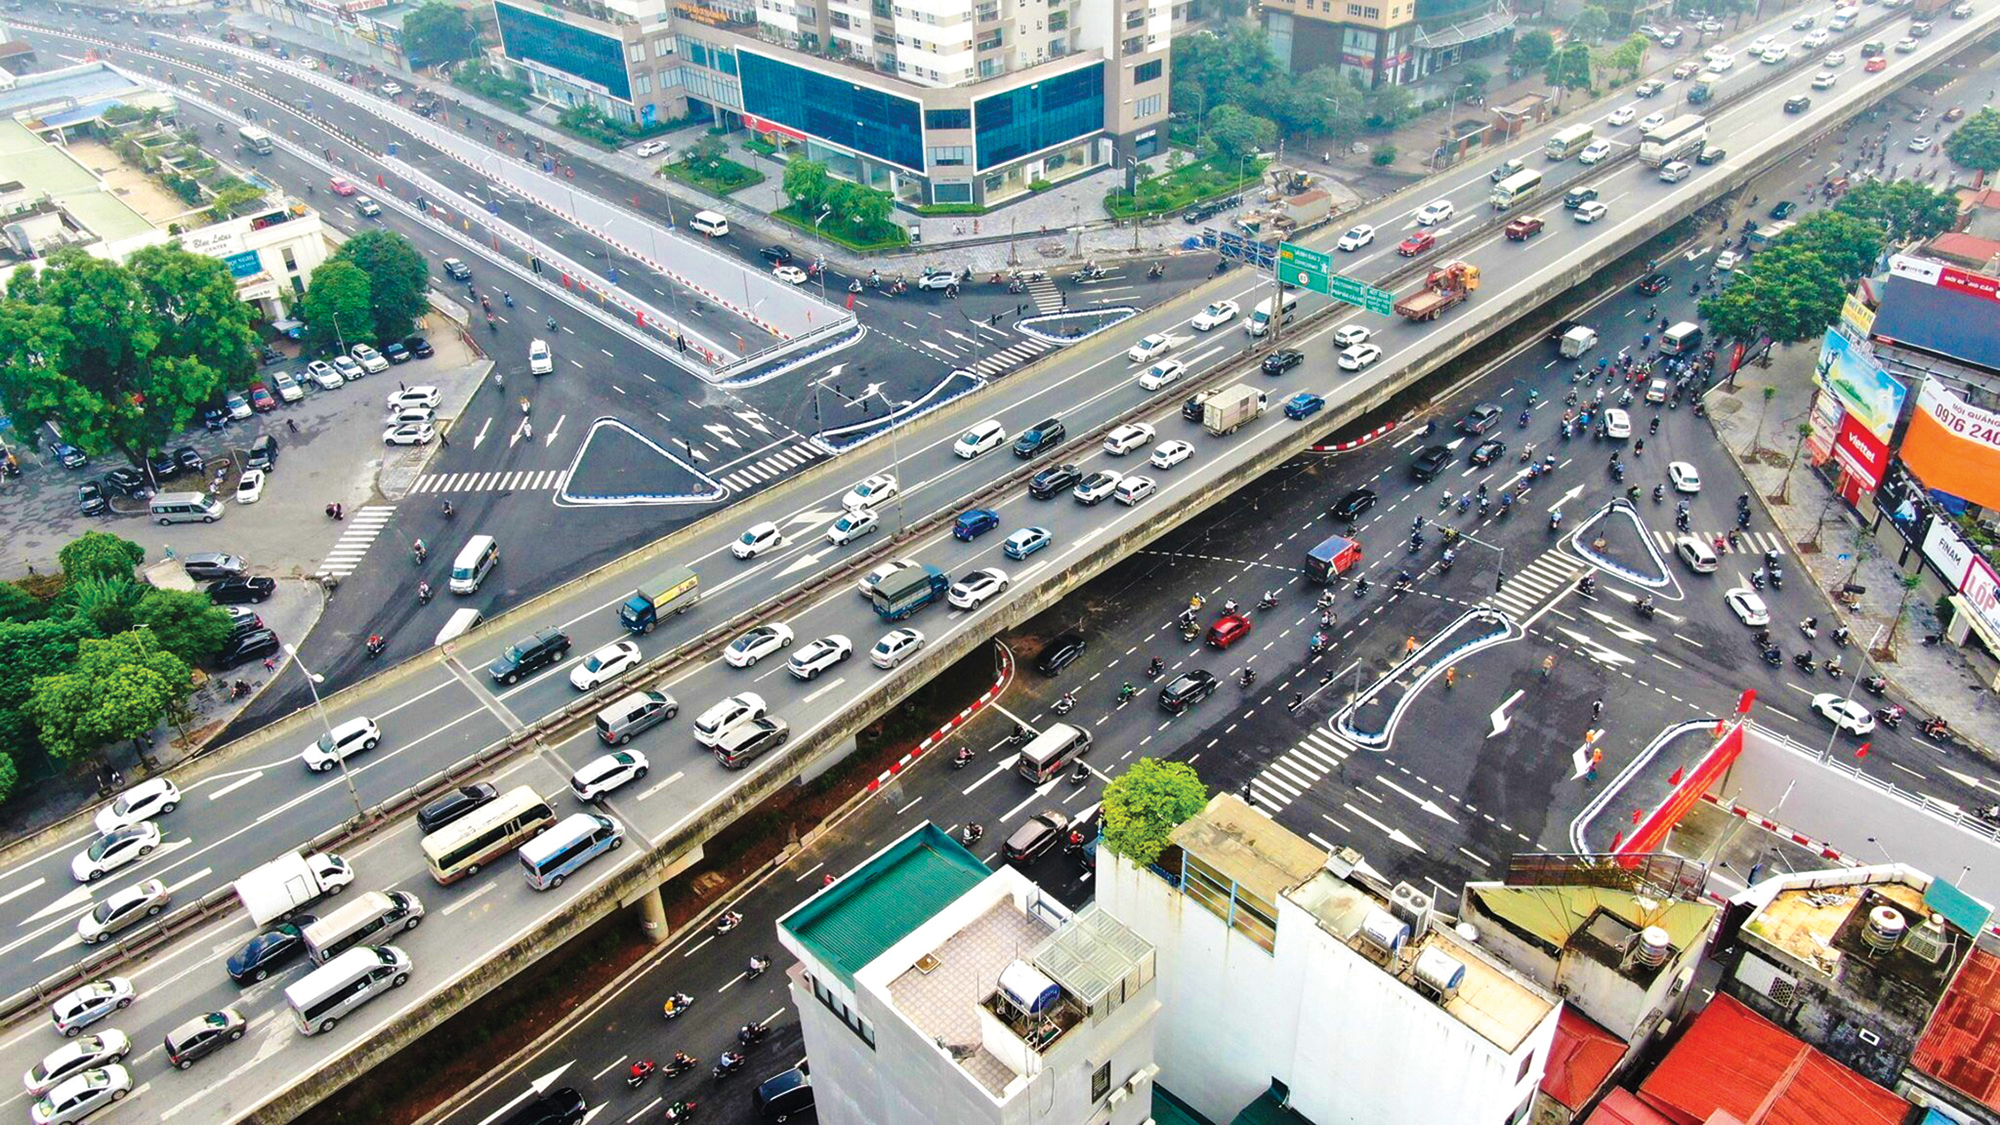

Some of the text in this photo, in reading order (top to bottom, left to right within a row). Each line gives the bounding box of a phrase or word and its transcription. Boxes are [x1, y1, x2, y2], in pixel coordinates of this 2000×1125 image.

[1935, 403, 1966, 433] 0976
[1849, 431, 1875, 464] viettel
[1938, 538, 1962, 566] FINAM
